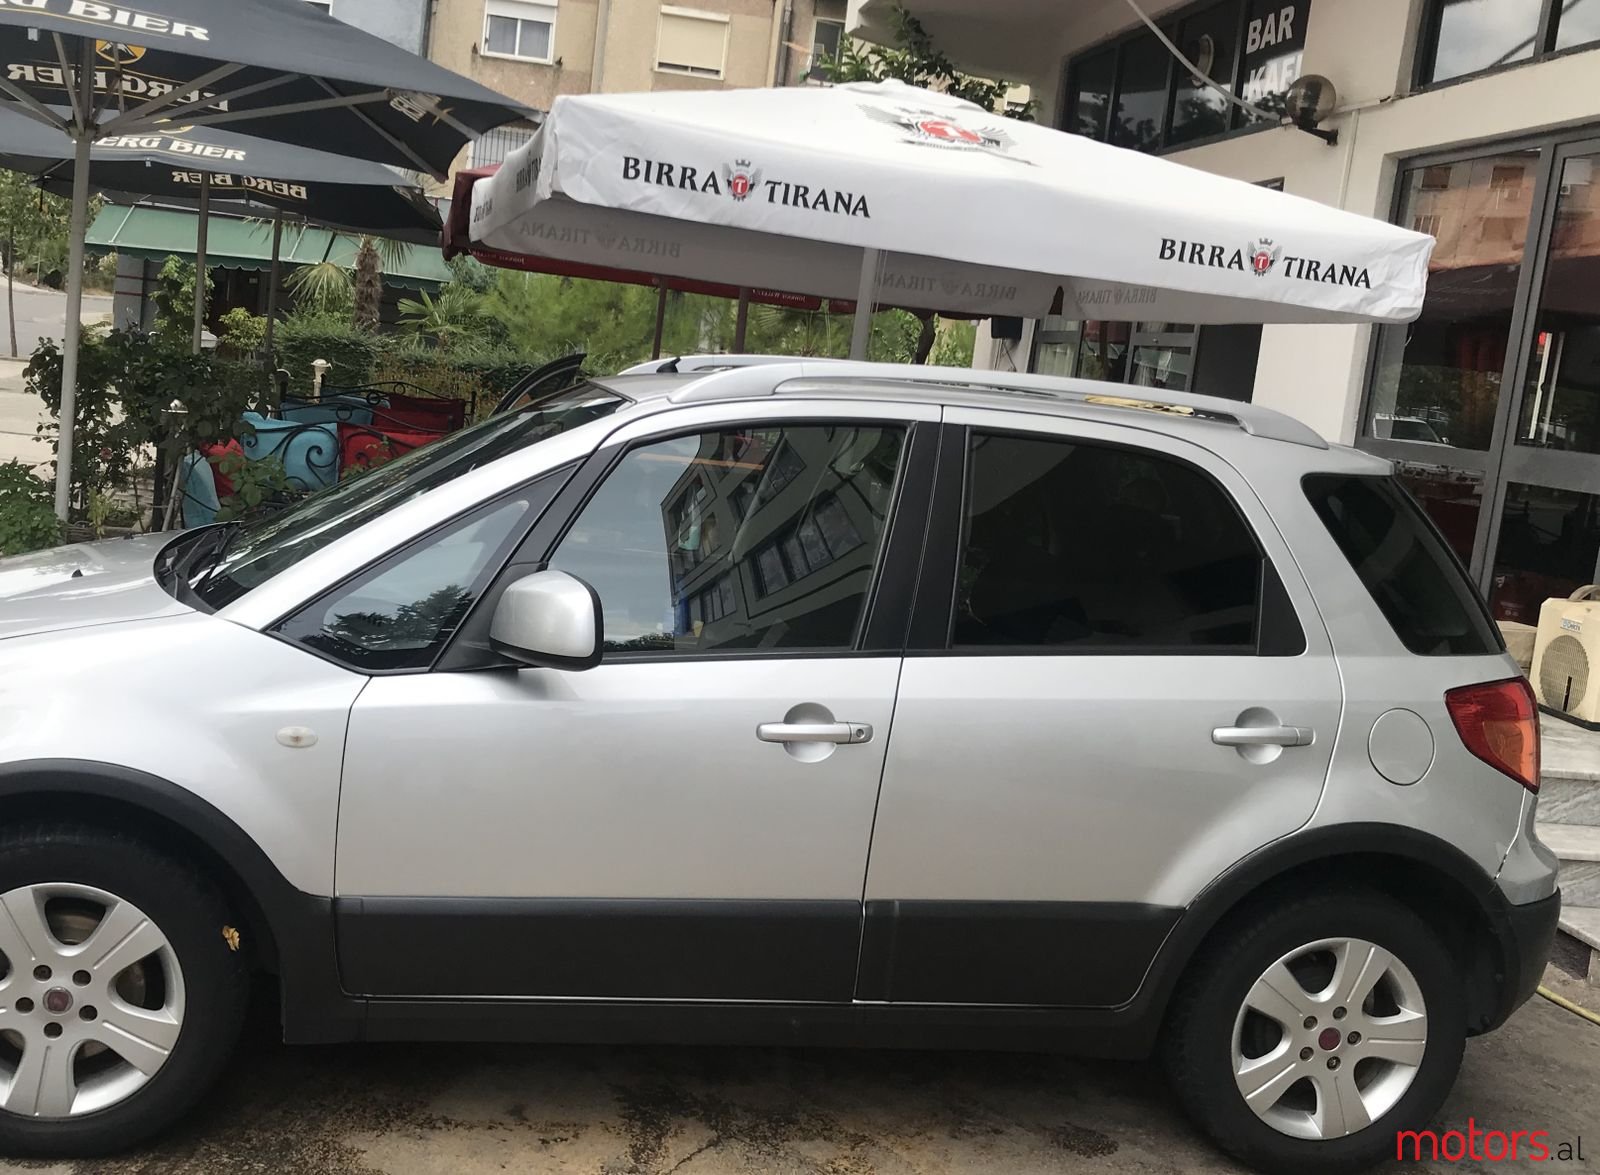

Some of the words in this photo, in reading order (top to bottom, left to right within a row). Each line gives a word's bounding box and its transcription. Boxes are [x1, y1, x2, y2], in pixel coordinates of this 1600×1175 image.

[67, 0, 210, 41] BIER
[1246, 5, 1295, 54] BAR
[72, 136, 162, 149] ERG
[168, 139, 247, 161] BIER
[622, 156, 722, 196] BIRRA
[764, 180, 871, 218] TIRANA
[1159, 238, 1244, 271] BIRRA
[1283, 256, 1372, 289] TIRANA
